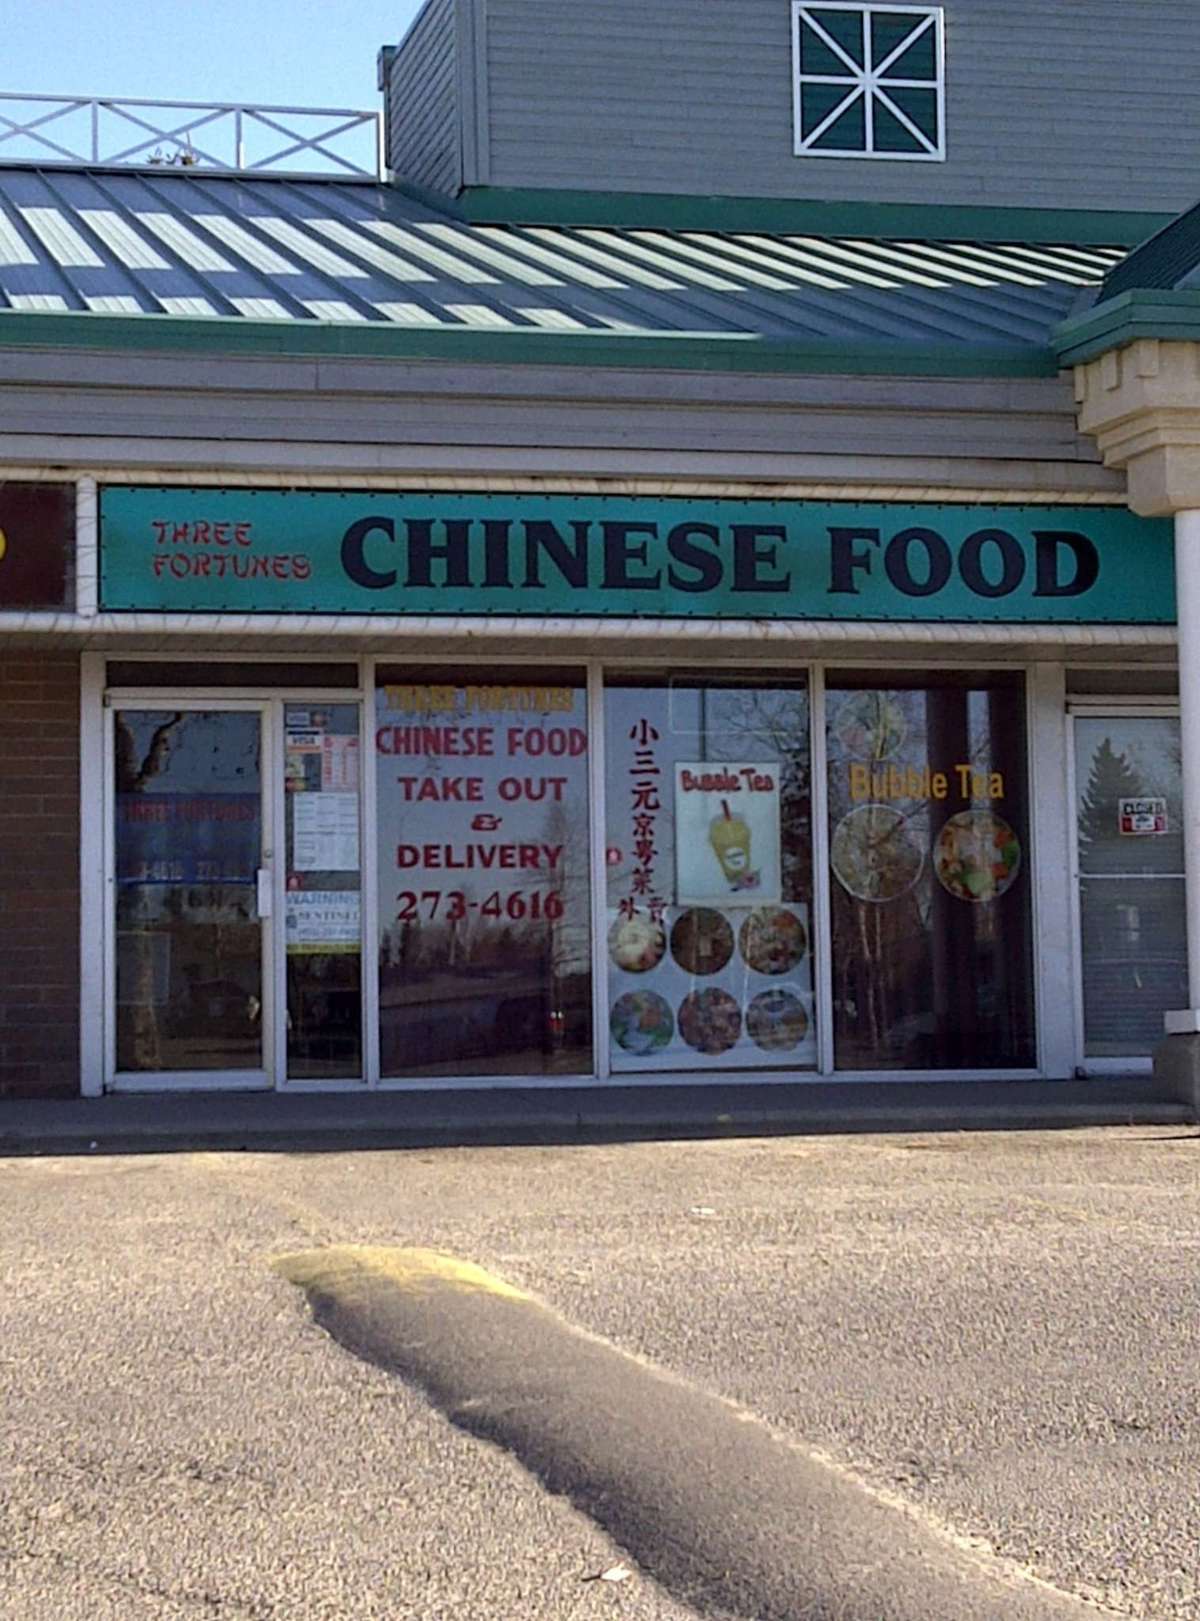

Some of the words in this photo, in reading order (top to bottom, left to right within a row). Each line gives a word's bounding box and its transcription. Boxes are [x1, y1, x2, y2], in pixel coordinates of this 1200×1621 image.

[152, 521, 253, 547] THREE
[152, 552, 312, 580] FORTUNES
[340, 516, 792, 594] CHINESE
[827, 526, 1099, 598] FOOD
[375, 726, 495, 757] CHINESE
[507, 727, 588, 758] FOOD
[398, 777, 485, 802] TAKE
[497, 777, 568, 802] OUT
[681, 766, 740, 793] Bubble
[740, 768, 775, 793] Tea
[850, 764, 948, 800] Bubble
[956, 764, 1005, 800] Tea
[471, 814, 502, 832] &
[397, 844, 564, 869] DELIVERY
[397, 890, 564, 921] 273-4616
